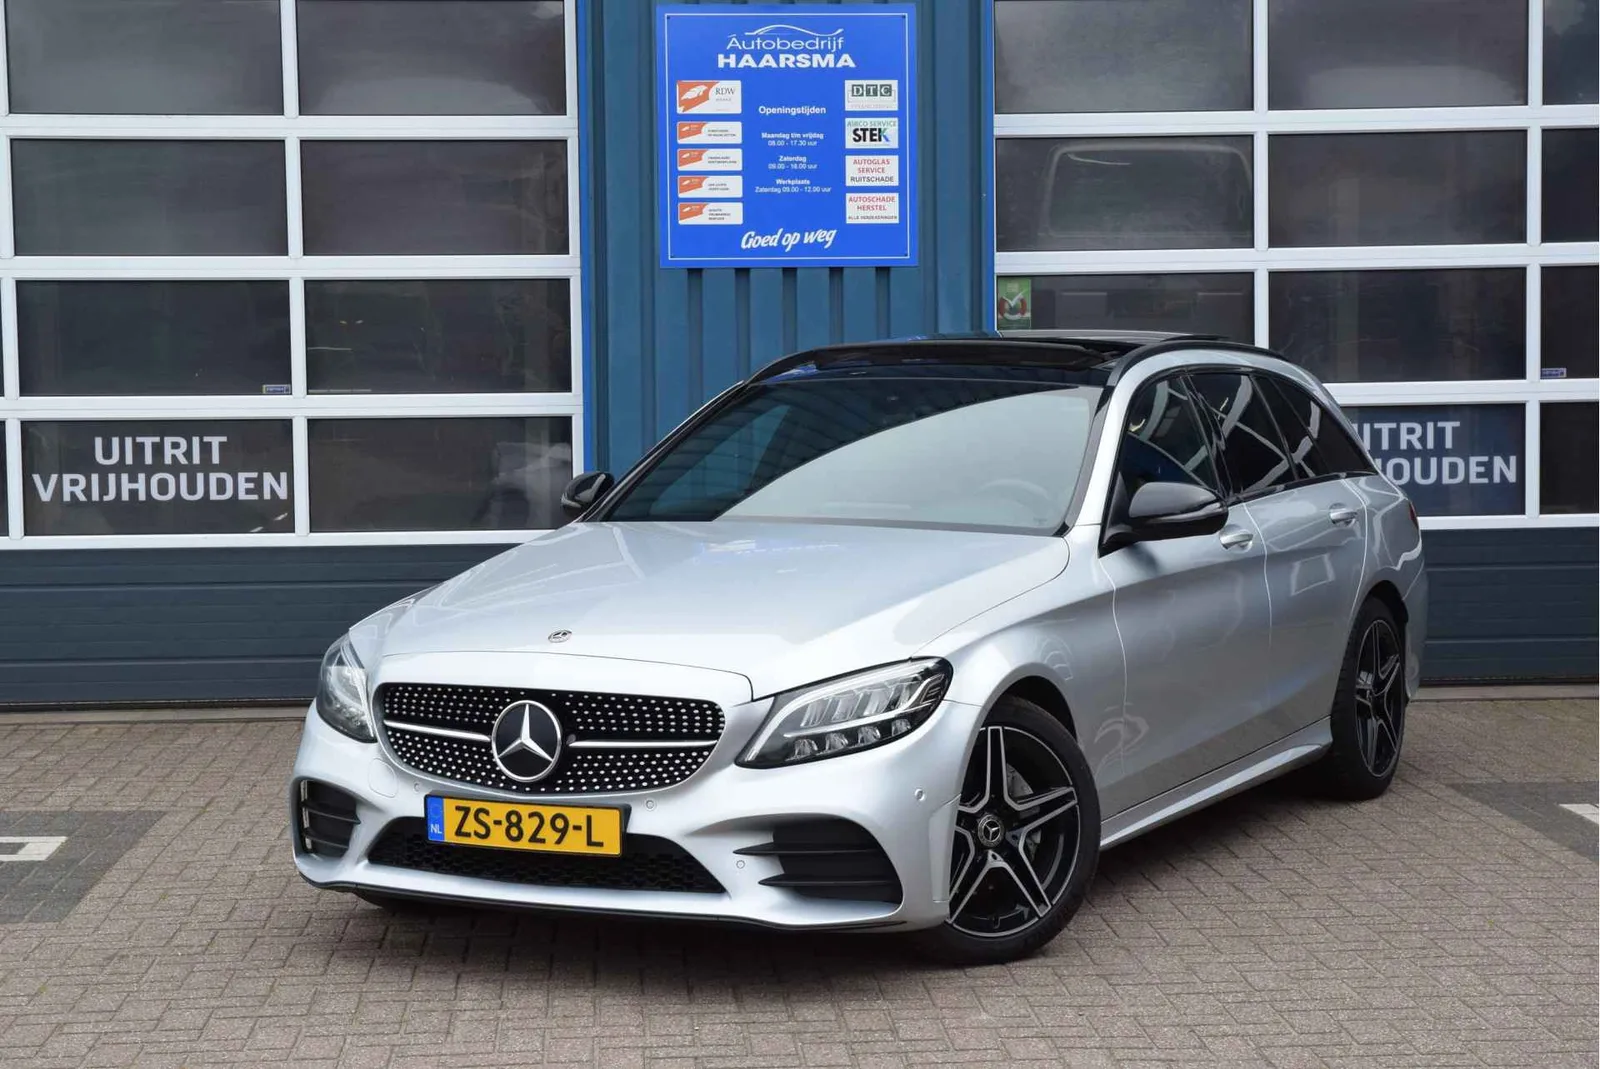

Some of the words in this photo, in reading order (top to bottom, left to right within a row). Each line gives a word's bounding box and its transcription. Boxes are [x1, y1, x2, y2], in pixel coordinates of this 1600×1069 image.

[726, 37, 844, 52] Autobedrijf
[717, 53, 856, 68] HAARSMA
[715, 87, 736, 96] RDW
[851, 84, 892, 97] DTC
[758, 105, 827, 116] Openingstijden
[870, 120, 897, 128] SERVICE
[761, 132, 790, 140] Maandag
[802, 132, 824, 140] vrijdag
[852, 127, 890, 143] STEK
[741, 228, 784, 249] Goed
[781, 232, 801, 252] op
[803, 229, 837, 249] weg
[94, 436, 228, 465] UITRIT
[1374, 455, 1517, 485] OUDEN
[32, 471, 288, 502] VRIJHOUDEN
[430, 823, 443, 835] NL
[454, 805, 604, 848] ZS-829-L
